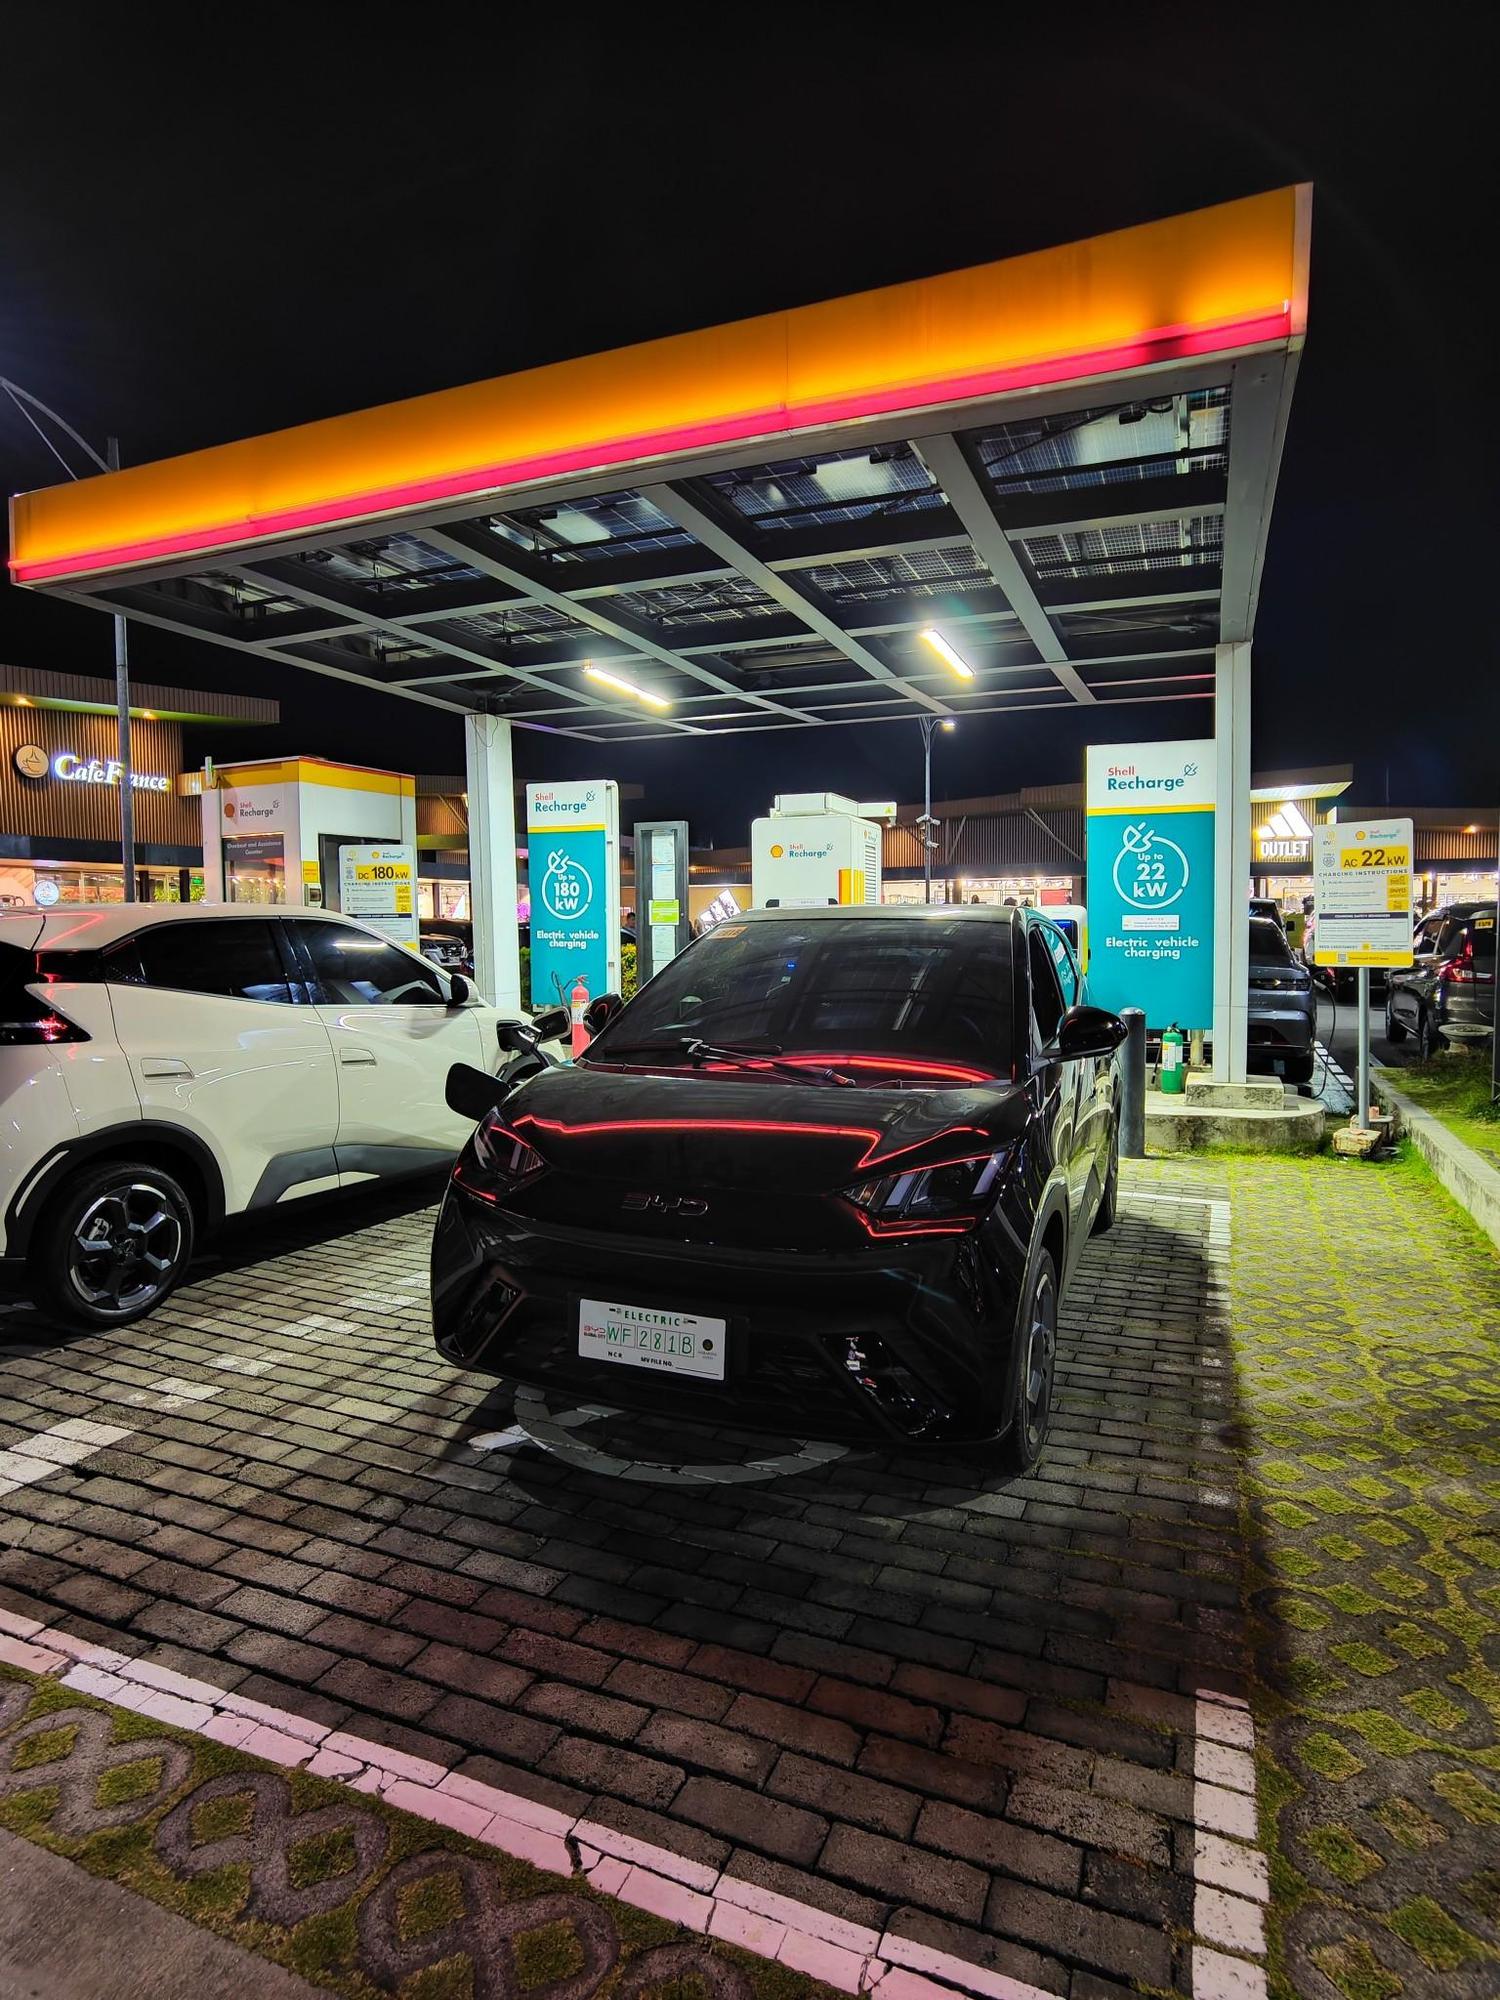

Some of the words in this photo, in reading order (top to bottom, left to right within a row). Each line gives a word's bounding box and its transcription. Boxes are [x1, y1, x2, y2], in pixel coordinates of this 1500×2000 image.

[104, 760, 168, 790] Fance
[1108, 766, 1135, 776] Shell
[1108, 776, 1184, 791] Recharge
[240, 808, 274, 817] Recharge
[535, 801, 587, 813] Recharge
[789, 849, 828, 858] Recharge
[1261, 840, 1310, 857] OUTLET
[1137, 853, 1151, 862] Up
[1343, 859, 1358, 868] AC
[1361, 849, 1386, 867] 22
[1387, 855, 1405, 866] kW
[371, 866, 394, 880] 180
[395, 871, 408, 880] kW
[557, 872, 568, 882] Up
[1136, 863, 1165, 880] 22
[1355, 868, 1408, 876] INSTRUCTIONS
[553, 881, 580, 897] 180
[1133, 882, 1168, 898] kW
[555, 896, 578, 910] kW
[536, 929, 565, 939] Electric
[569, 929, 599, 939] vehicle
[549, 939, 587, 949] charging
[1105, 936, 1148, 948] Electric
[1154, 935, 1199, 948] vehicle
[1124, 947, 1180, 959] charging
[624, 1310, 680, 1326] ELECTRIC
[607, 1326, 631, 1343] WF
[639, 1330, 693, 1354] 281B
